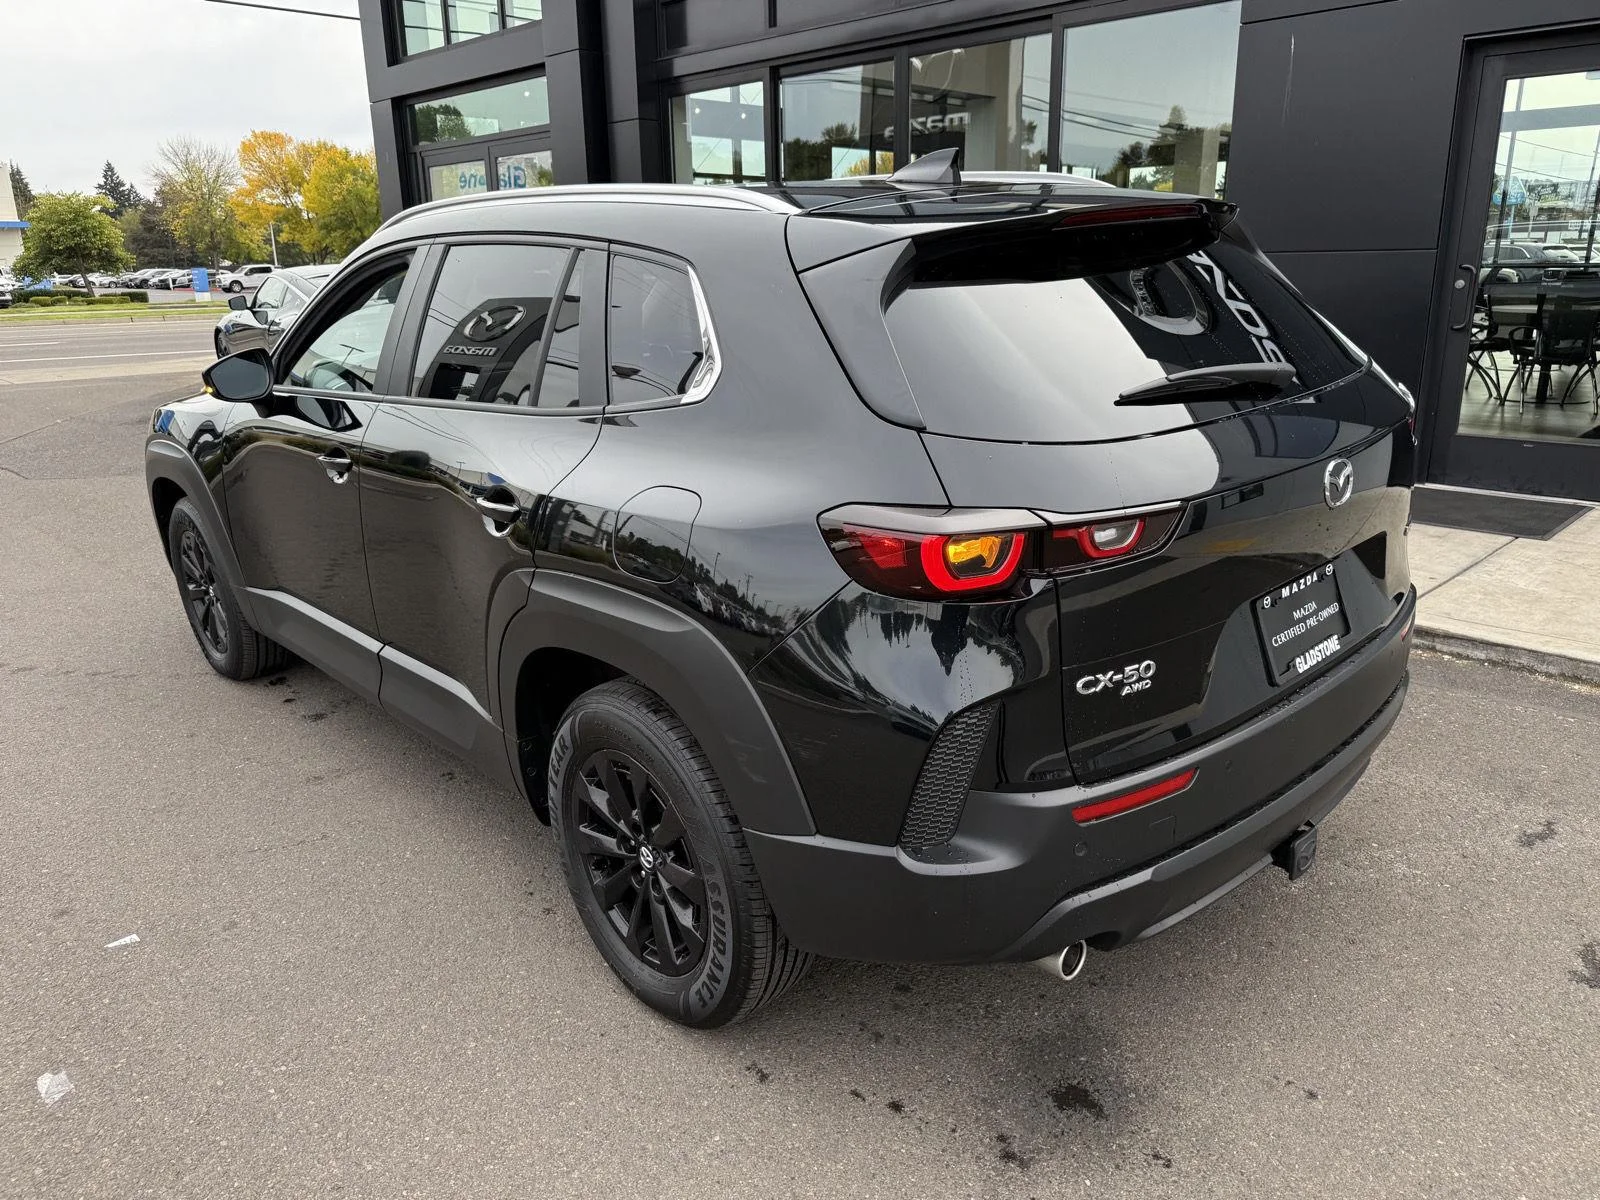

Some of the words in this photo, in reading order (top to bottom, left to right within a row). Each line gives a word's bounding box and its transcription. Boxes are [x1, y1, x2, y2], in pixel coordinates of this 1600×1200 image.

[1281, 571, 1318, 598] MAZDA
[1272, 622, 1306, 647] CERTIFIED
[1306, 602, 1340, 629] PRE-OWNED
[1293, 601, 1318, 620] MAZDA
[1295, 634, 1341, 674] GLADSTONE
[1076, 660, 1156, 695] CX-50
[1120, 679, 1152, 696] AWD
